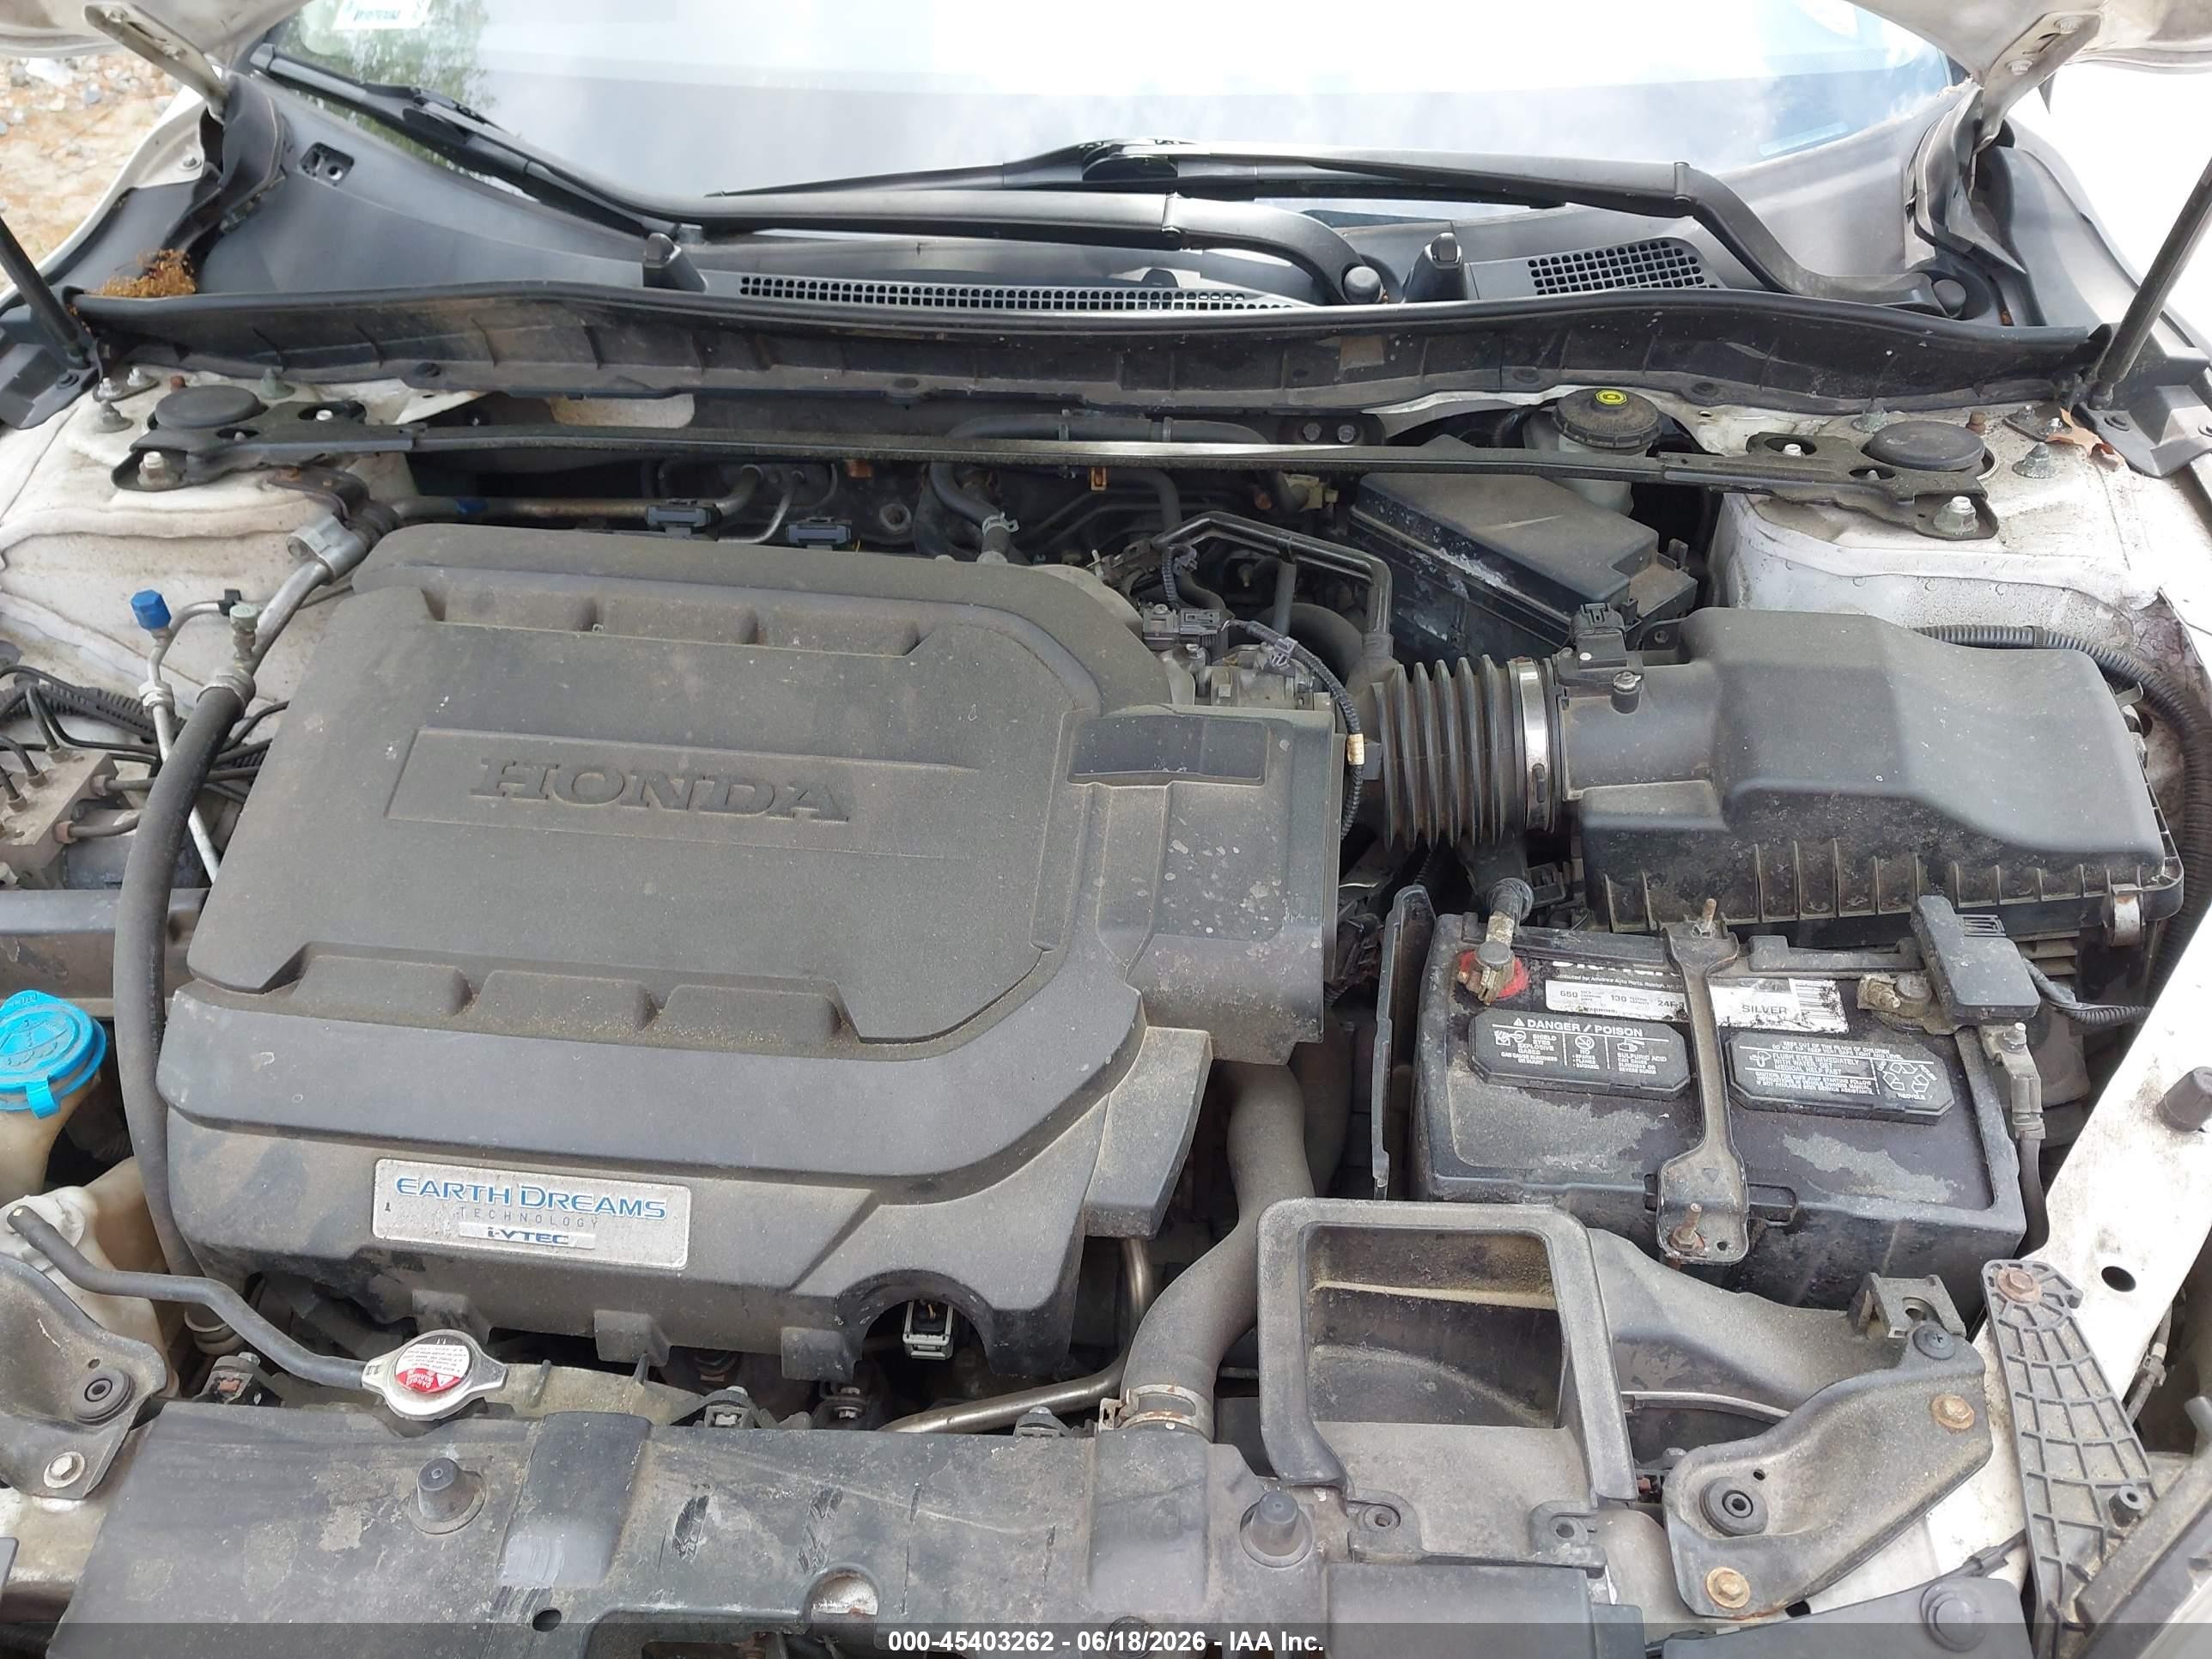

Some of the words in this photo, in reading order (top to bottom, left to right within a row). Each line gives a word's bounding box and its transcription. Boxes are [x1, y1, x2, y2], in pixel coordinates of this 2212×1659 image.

[469, 757, 849, 823] HONDA
[1560, 989, 1577, 998] 650
[1741, 1004, 1788, 1015] SILVER
[1527, 1018, 1581, 1032] DANGER
[1583, 1024, 1591, 1032] /
[1595, 1024, 1643, 1037] POISON
[1617, 1052, 1650, 1060] SULFURIC
[1772, 1052, 1794, 1060] FLUSH
[1815, 1054, 1859, 1066] IMMEDIATELY
[1774, 1063, 1802, 1072] MEDICAL
[396, 1177, 513, 1205] EARTH
[459, 1206, 599, 1229] TECHNOLOGY
[487, 1226, 569, 1245] i-VTEC
